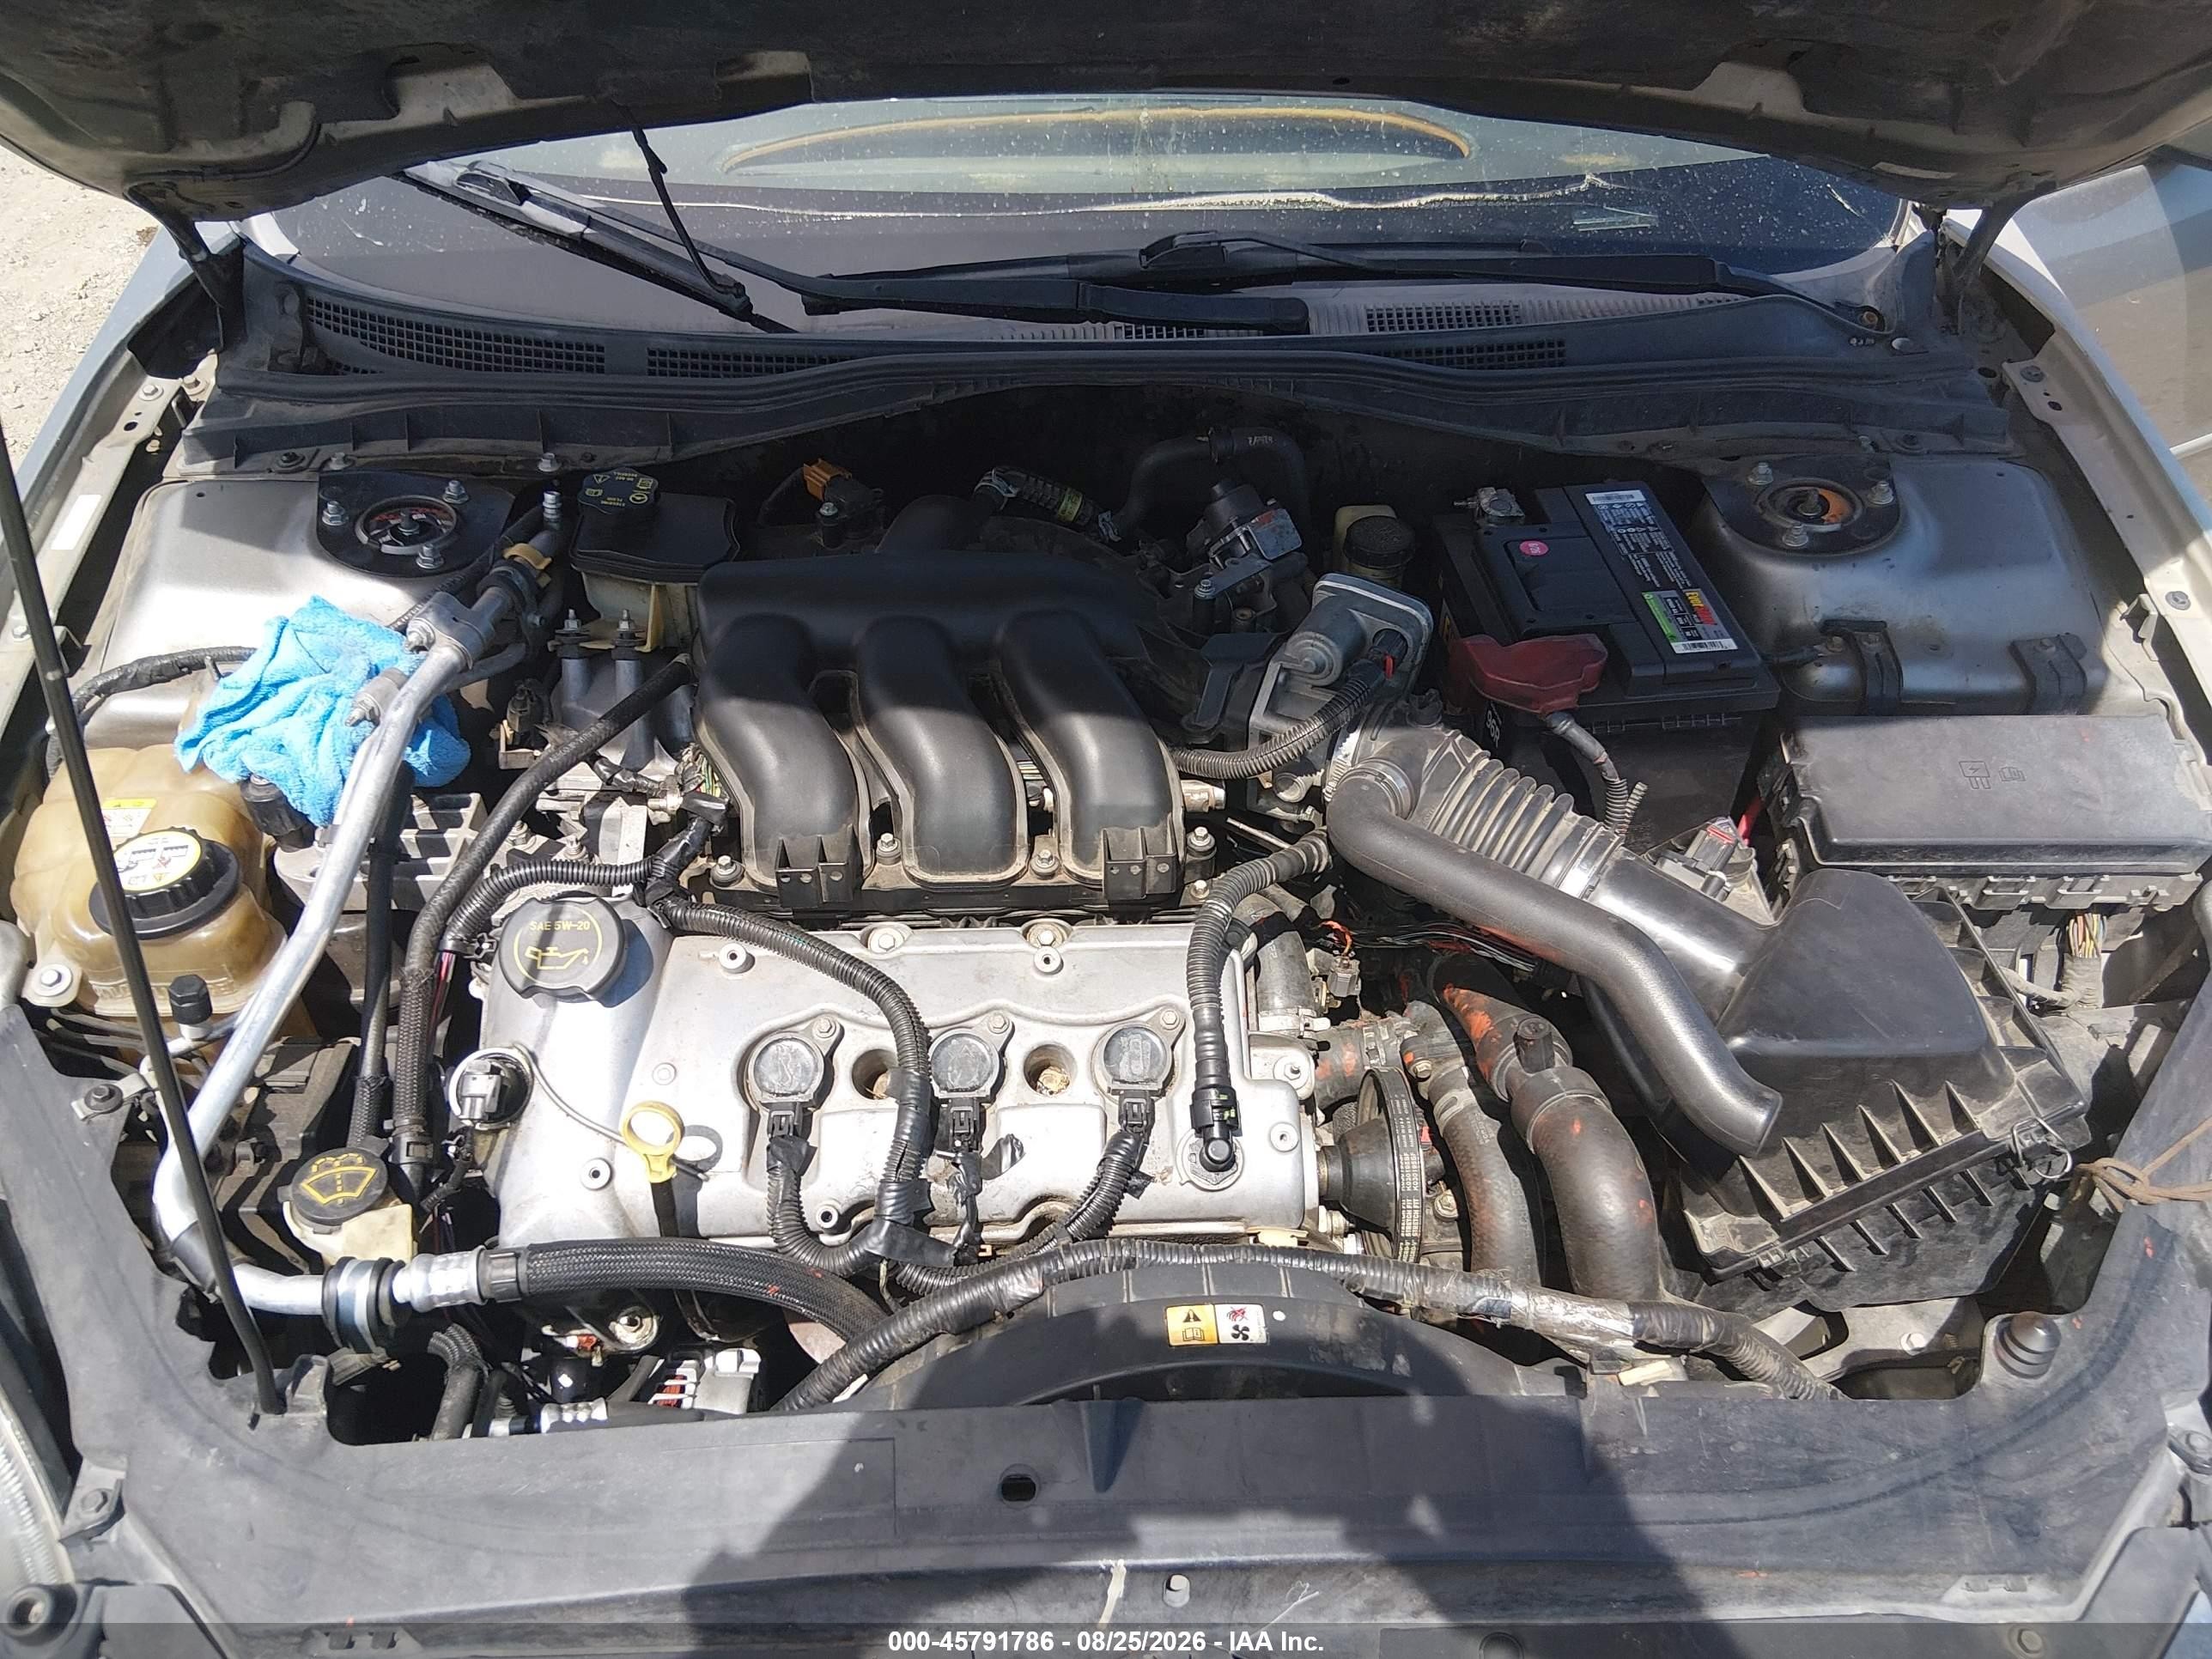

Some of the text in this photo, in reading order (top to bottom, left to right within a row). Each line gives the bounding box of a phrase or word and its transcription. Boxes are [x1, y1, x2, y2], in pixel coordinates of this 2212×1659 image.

[1486, 709, 1500, 748] 96R
[529, 920, 591, 932] SAE 5W-20
